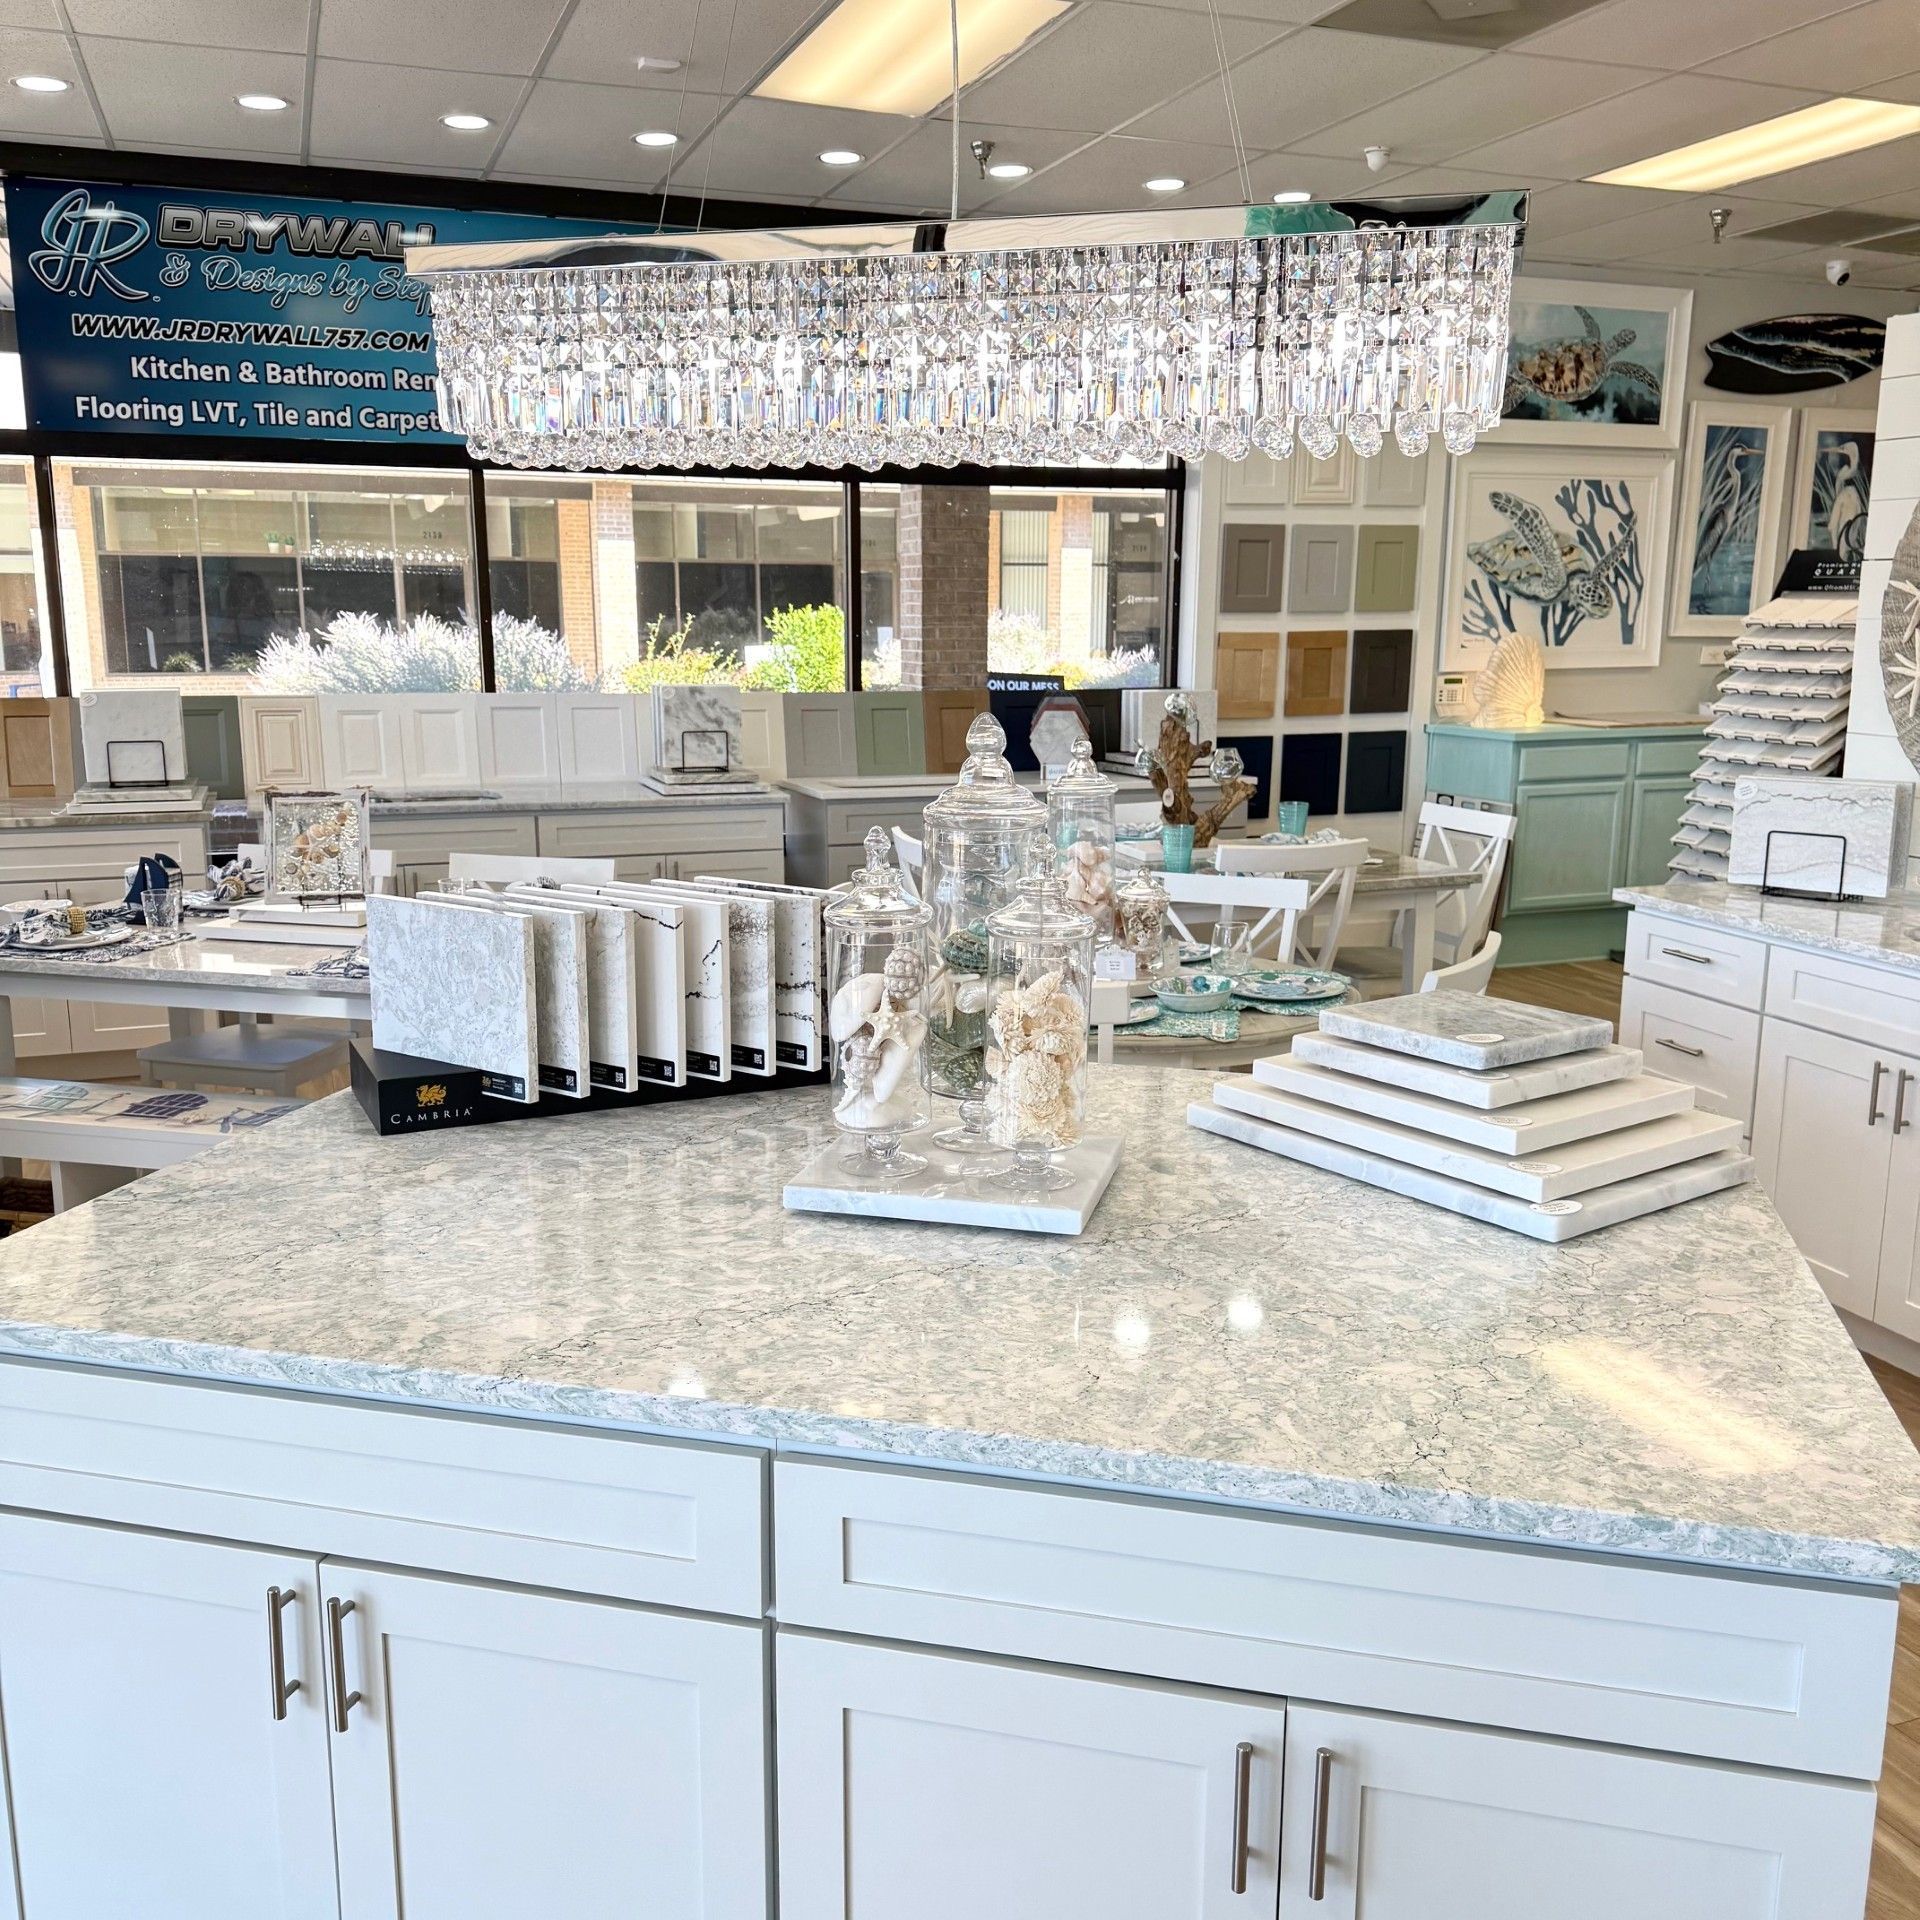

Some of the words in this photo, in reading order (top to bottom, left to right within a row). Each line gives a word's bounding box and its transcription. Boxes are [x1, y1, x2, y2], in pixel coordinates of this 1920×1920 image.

[159, 252, 191, 287] &
[200, 255, 327, 310] Designs
[329, 263, 369, 313] by
[71, 313, 431, 353] WWW.JRDRYWALL757.COM
[130, 355, 231, 382] Kitchen
[238, 361, 259, 384] &
[265, 362, 387, 390] Bathroom
[75, 396, 184, 427] Flooring
[191, 400, 247, 427] LVT,
[253, 402, 299, 426] Tile
[306, 405, 351, 428] and
[359, 407, 439, 434] Carpet
[1006, 680, 1030, 691] OUR
[1031, 681, 1060, 691] MESS
[390, 1107, 472, 1125] CAMBRIA
